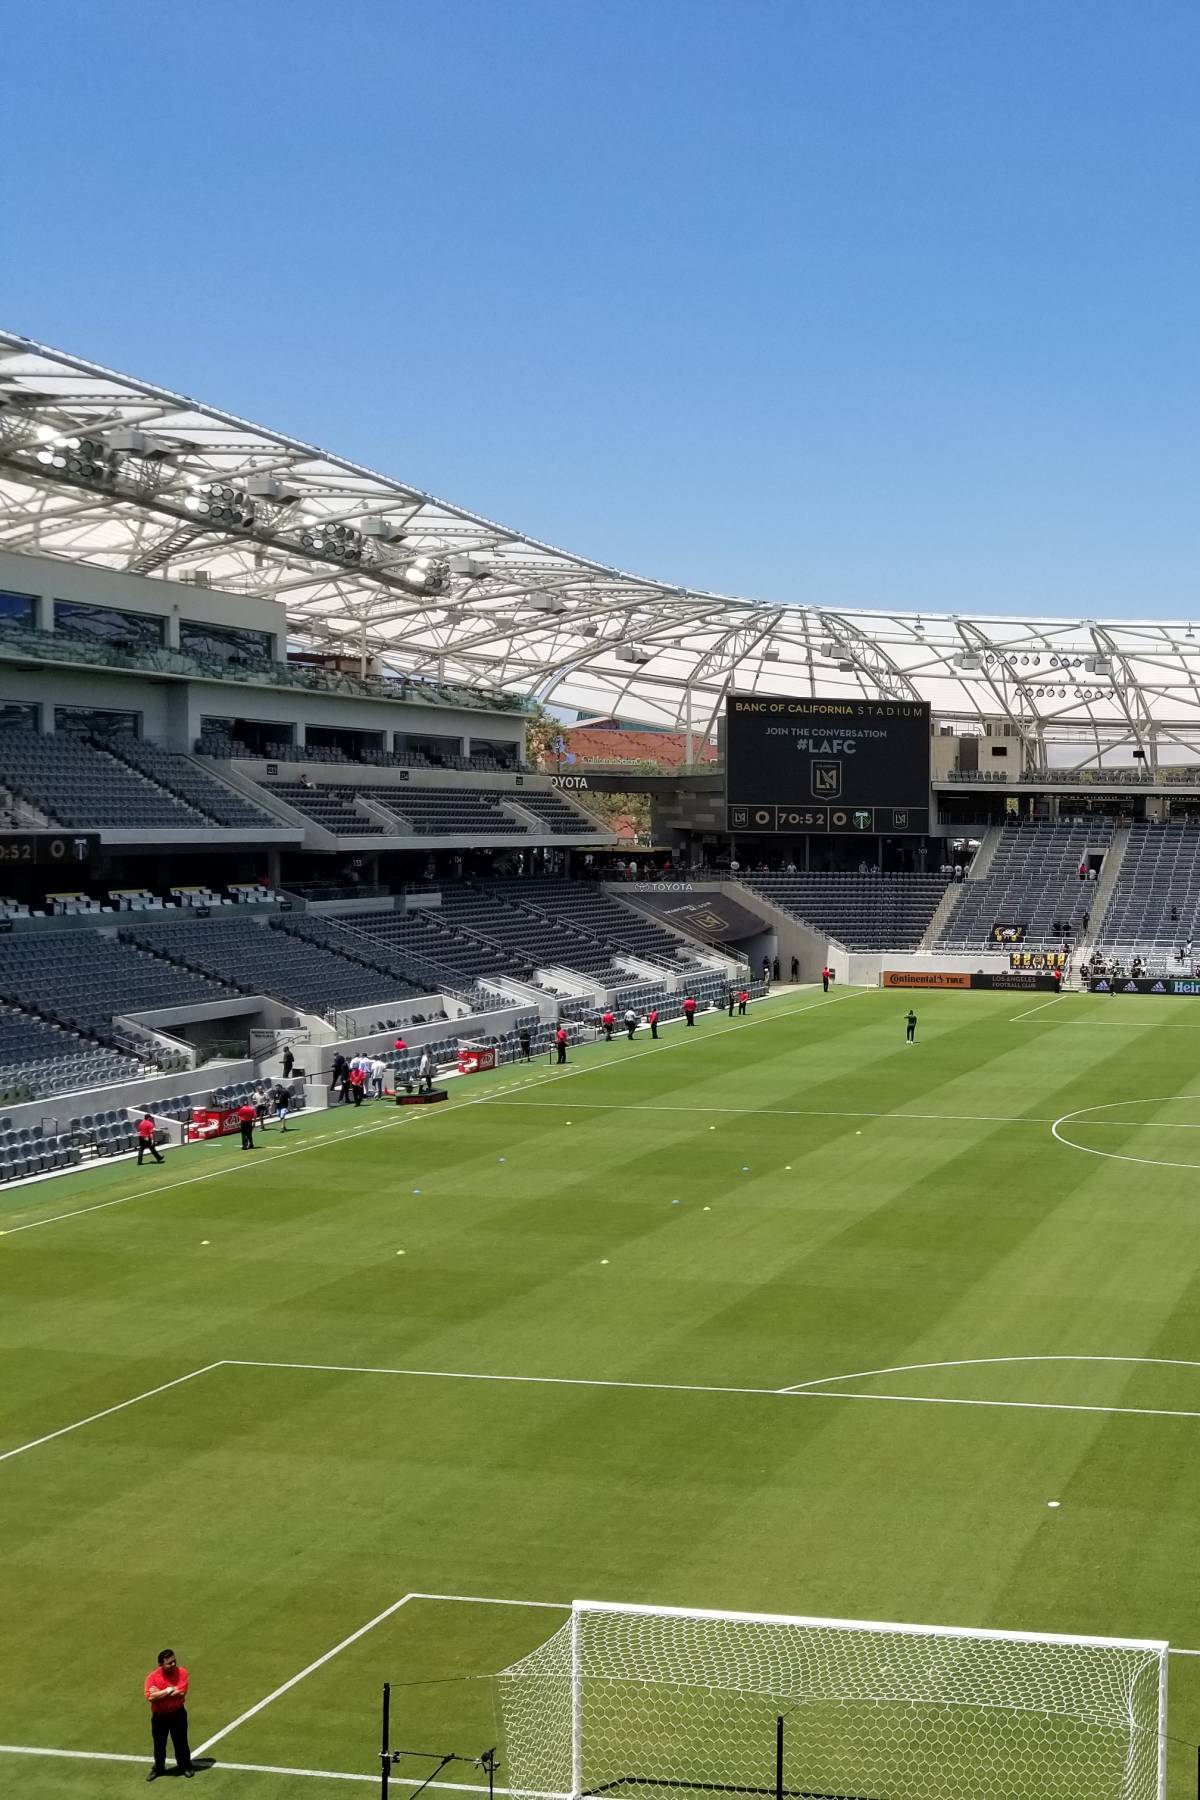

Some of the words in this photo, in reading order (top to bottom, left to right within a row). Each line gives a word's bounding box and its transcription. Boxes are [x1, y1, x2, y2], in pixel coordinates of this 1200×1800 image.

[735, 702, 767, 712] BANC
[769, 703, 785, 713] OF
[787, 704, 853, 715] CALIFORNIA
[857, 706, 922, 717] STADIUM
[764, 727, 789, 737] JOIN
[791, 728, 810, 737] THE
[812, 728, 887, 738] CONVERSATION
[796, 738, 857, 754] #LAFC
[551, 776, 588, 789] OYOTA
[755, 810, 770, 825] 0
[778, 813, 825, 825] 70:52
[832, 812, 847, 826] 0
[50, 839, 65, 858] 0
[651, 883, 693, 891] TOYOTA
[889, 974, 937, 984] Continental
